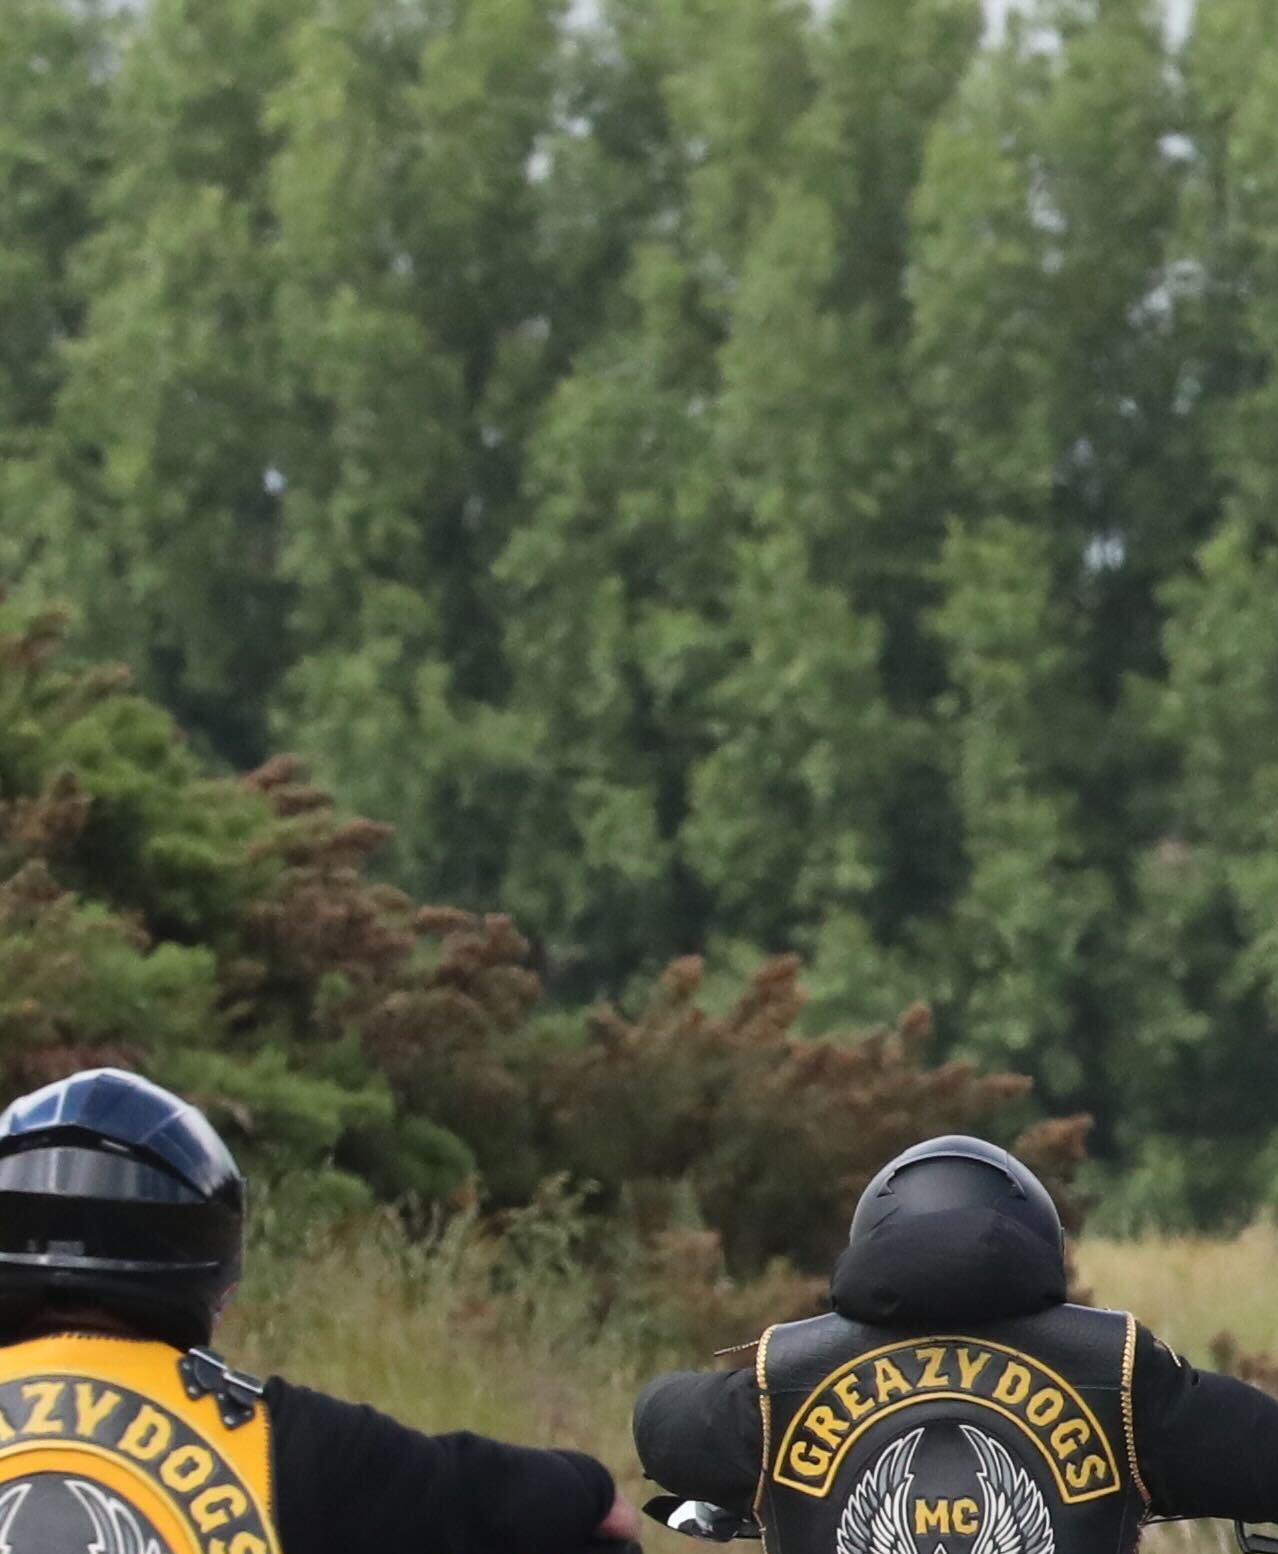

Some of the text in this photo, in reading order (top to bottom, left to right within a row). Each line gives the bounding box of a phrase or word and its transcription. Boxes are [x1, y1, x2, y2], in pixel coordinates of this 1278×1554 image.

[789, 1347, 1106, 1489] GREAZY DOGS
[914, 1498, 979, 1536] MC
